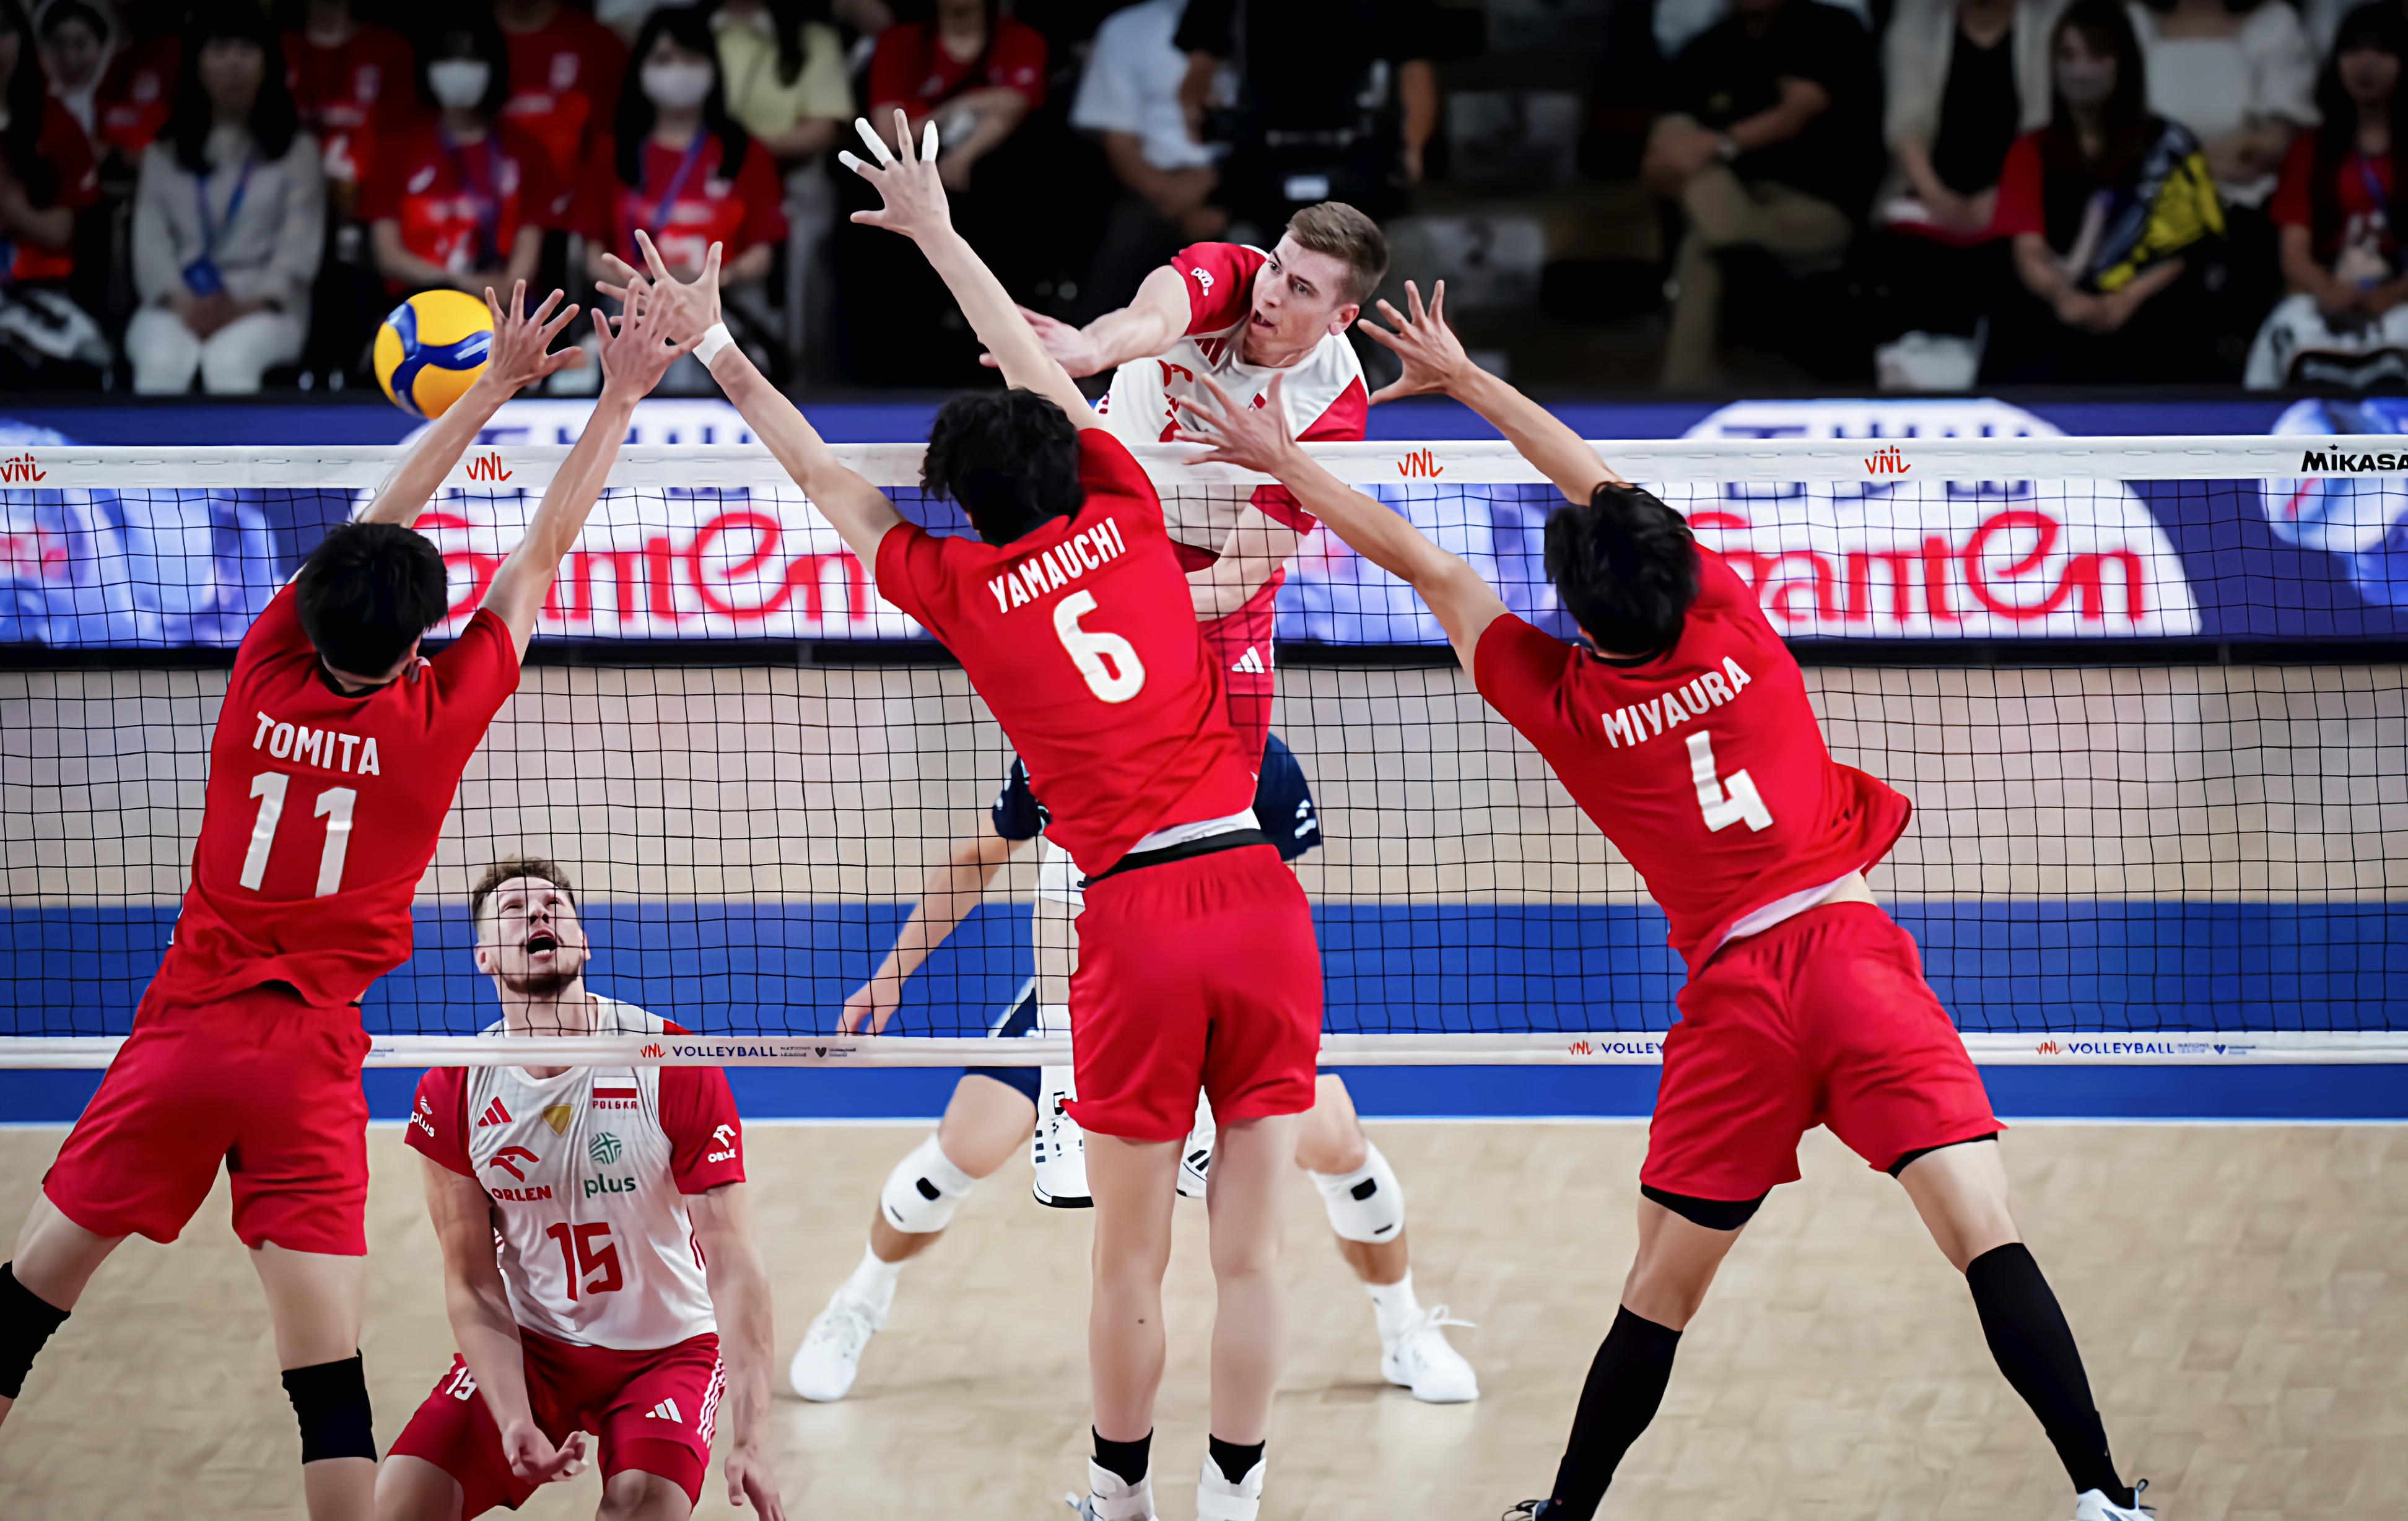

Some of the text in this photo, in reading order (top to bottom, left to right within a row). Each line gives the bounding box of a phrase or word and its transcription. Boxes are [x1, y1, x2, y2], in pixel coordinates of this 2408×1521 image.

[0, 452, 46, 482] VNL
[466, 451, 512, 481] VNL
[1397, 447, 1444, 477] VNL
[1864, 445, 1911, 474] VNL
[2301, 443, 2408, 472] MIKASA
[411, 512, 866, 622] Snten
[988, 517, 1126, 614] YAMAUCHI
[1053, 589, 1146, 704] 6
[1602, 656, 1751, 748] MIYAURA
[253, 711, 380, 775] TOMITA
[1685, 730, 1774, 832] 4
[240, 772, 357, 898] 11
[640, 1043, 778, 1058] VNL VOLLEYBALL
[1569, 1040, 1594, 1055] VNL
[2036, 1040, 2062, 1055] VNL
[2069, 1042, 2175, 1054] VOLLEYBALL
[409, 1111, 435, 1138] plus
[491, 1185, 552, 1201] ORLEN
[584, 1174, 636, 1198] plus
[546, 1222, 623, 1302] 15
[446, 1367, 477, 1400] 15
